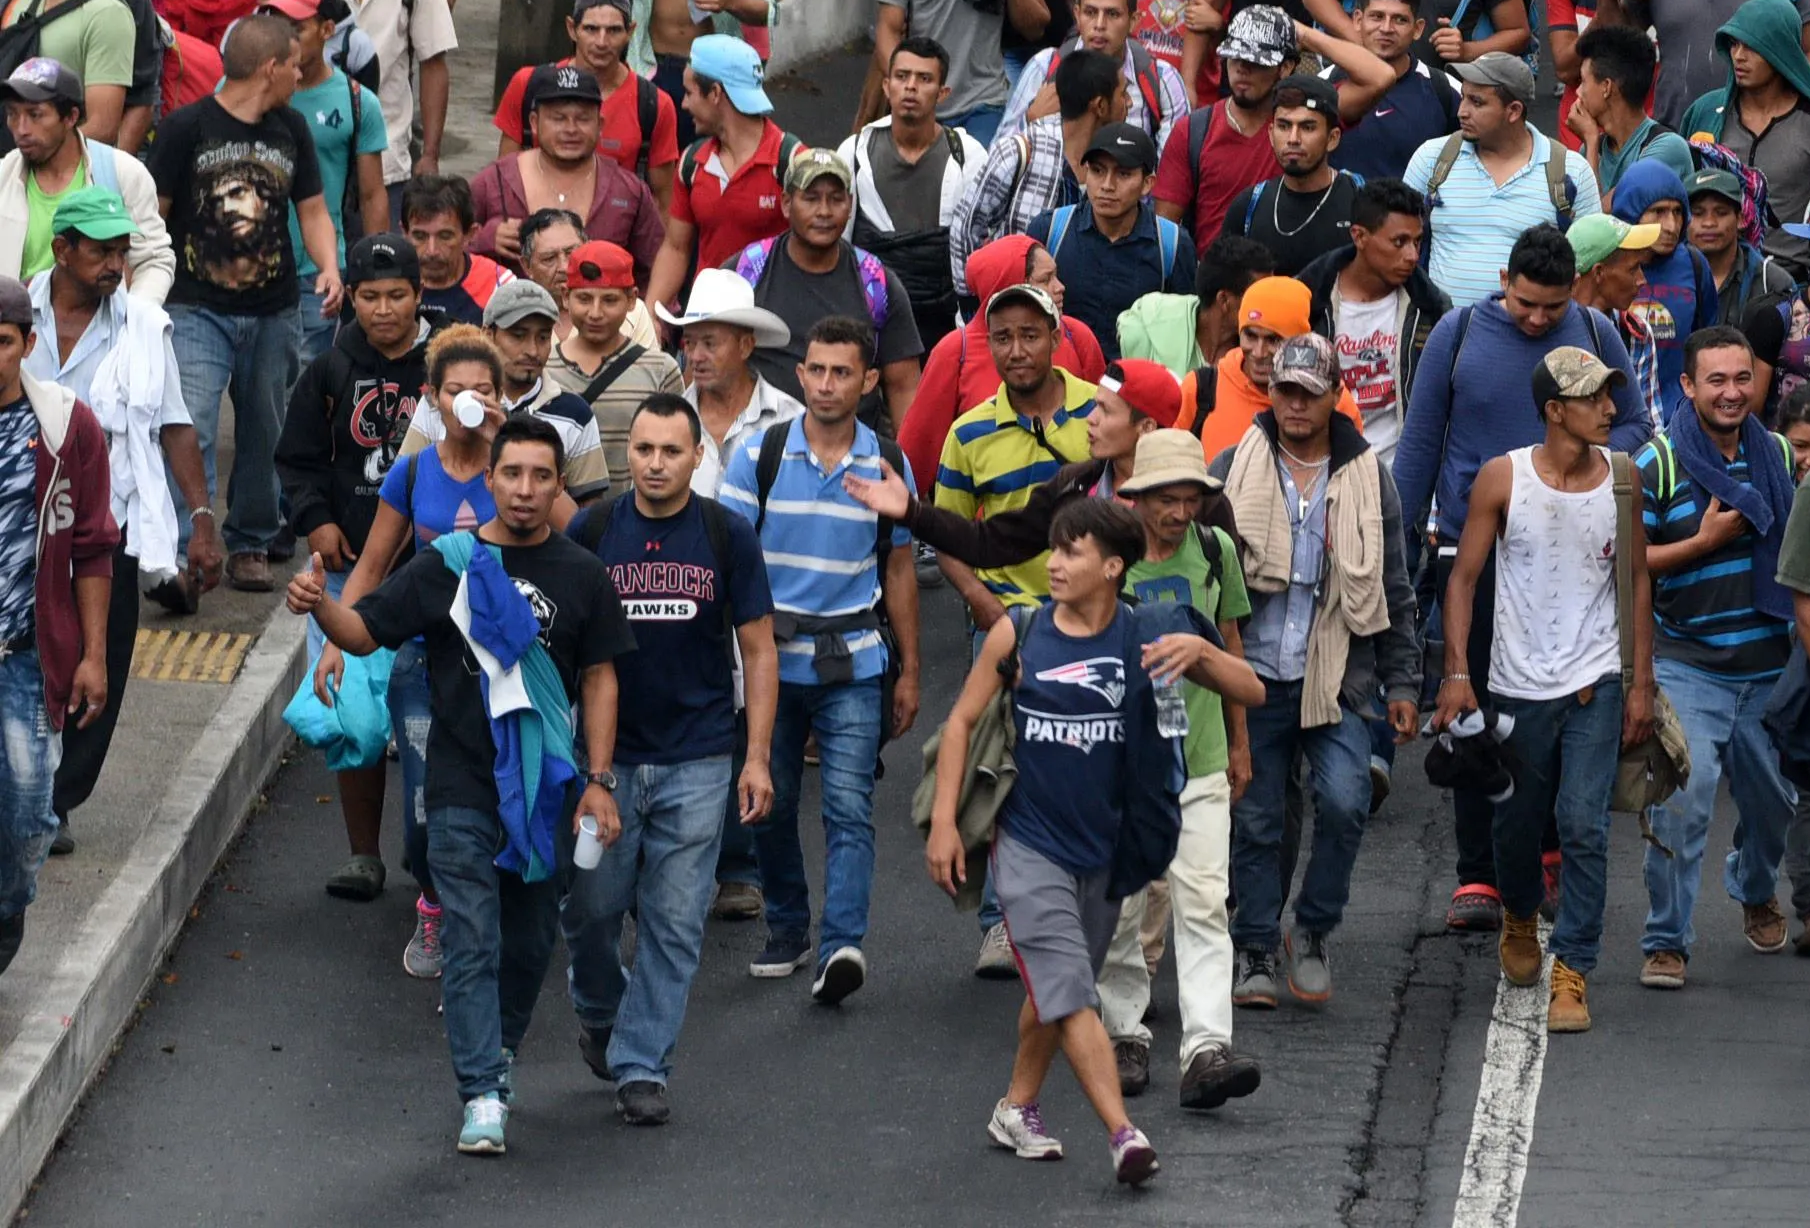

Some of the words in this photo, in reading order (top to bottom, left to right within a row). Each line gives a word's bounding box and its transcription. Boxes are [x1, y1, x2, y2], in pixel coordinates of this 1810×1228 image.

[1335, 329, 1398, 355] Rawling
[606, 562, 714, 602] ANCOCK
[1025, 715, 1126, 743] PATRIOTS
